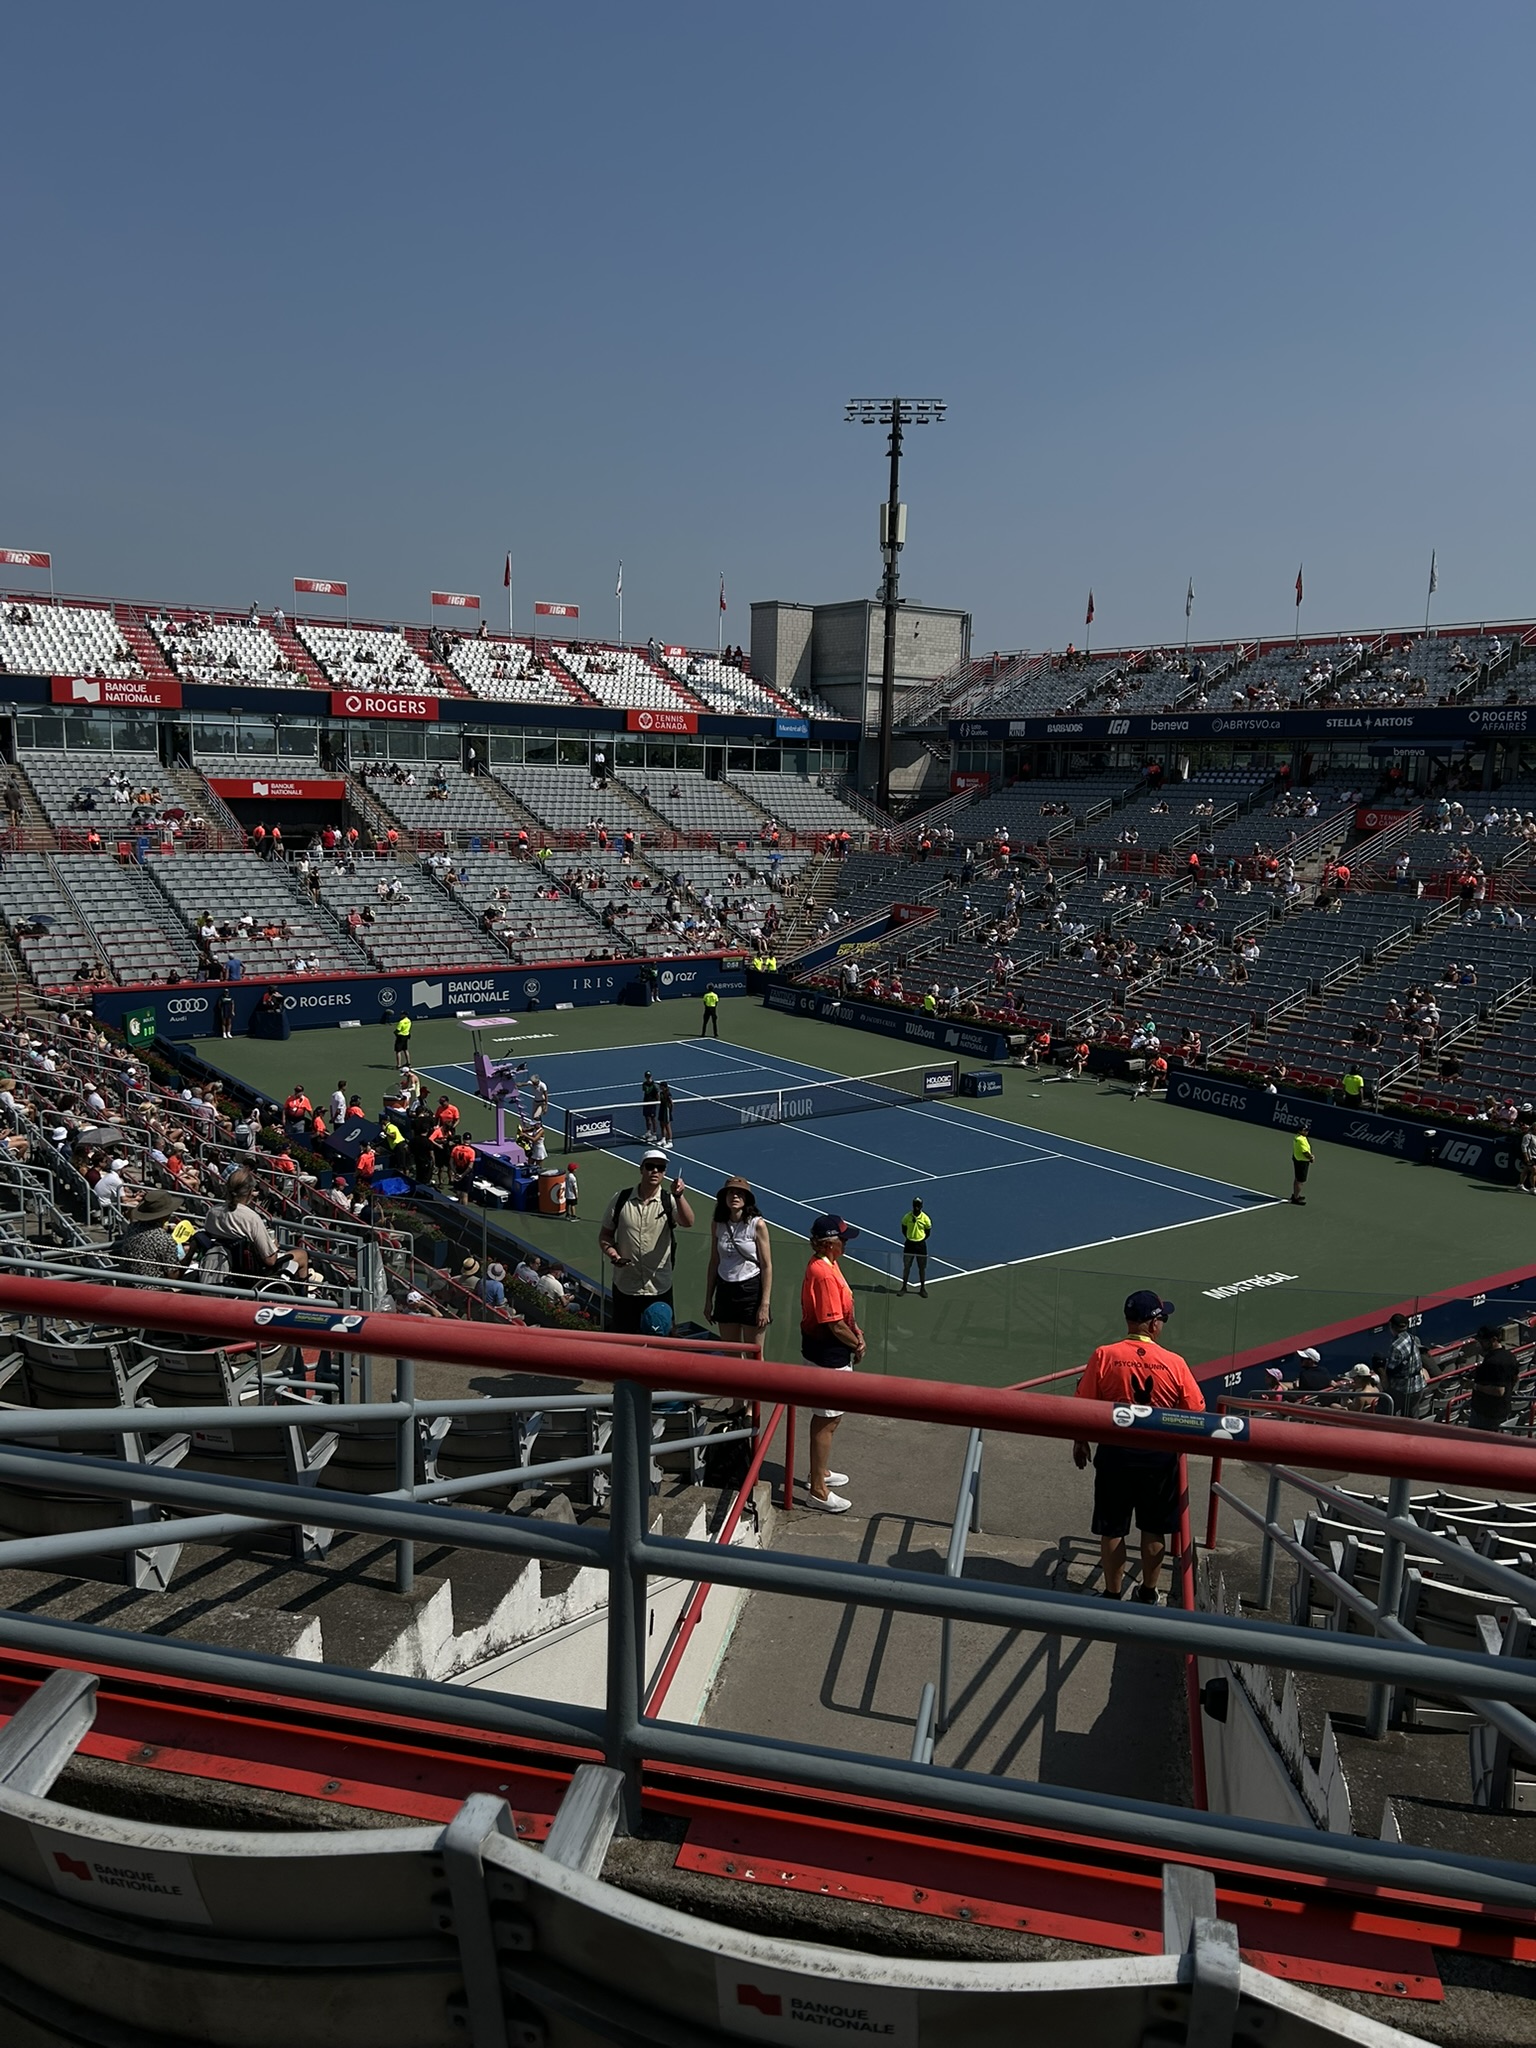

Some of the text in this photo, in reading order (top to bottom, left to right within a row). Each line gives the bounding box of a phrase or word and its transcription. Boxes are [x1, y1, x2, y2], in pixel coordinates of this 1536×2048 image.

[105, 682, 147, 693] BANQUE
[105, 692, 161, 704] NATIONALE
[365, 698, 427, 715] ROGERS
[655, 714, 684, 723] TENNIS
[1326, 716, 1414, 728] STELLA ARTOIS
[1482, 710, 1528, 722] ROGERS
[654, 722, 688, 731] CANADA
[779, 724, 801, 733] Montréal
[1046, 723, 1084, 733] BARBADOS
[1107, 719, 1131, 735] IGA
[1151, 718, 1189, 731] beneva
[1223, 719, 1281, 731] ABRYSVO.ca
[1481, 722, 1527, 732] AFFAIRES
[1008, 729, 1026, 737] KIND
[1393, 747, 1426, 756] beneva
[270, 788, 303, 796] NATIONALE
[572, 976, 614, 990] IRIS
[675, 971, 698, 982] razr
[448, 980, 495, 993] BANQUE
[300, 994, 352, 1008] ROGERS
[448, 990, 510, 1005] NATIONALE
[904, 1022, 936, 1040] Wilson
[961, 1032, 983, 1043] BANQUE
[959, 1040, 988, 1053] NATIONALE
[926, 1075, 953, 1085] HOLOGIC
[1192, 1086, 1248, 1111] ROGERS
[783, 1098, 813, 1118] TOUR
[1275, 1100, 1289, 1113] LA
[575, 1119, 612, 1133] HOLOGIC
[1343, 1121, 1395, 1146] Lindt
[1438, 1139, 1483, 1167] IGA
[1201, 1271, 1300, 1300] MONTRÉAL
[1472, 1293, 1487, 1307] 122
[1408, 1314, 1423, 1328] 123
[1114, 1360, 1142, 1369] PSYCHO
[1224, 1371, 1243, 1388] 123
[1161, 1416, 1205, 1427] DISPONIBLE
[93, 1863, 156, 1883] BANQUE
[98, 1874, 183, 1896] NATIONALE
[791, 1998, 869, 2020] BANQUE
[792, 2010, 895, 2035] NATIONALE
